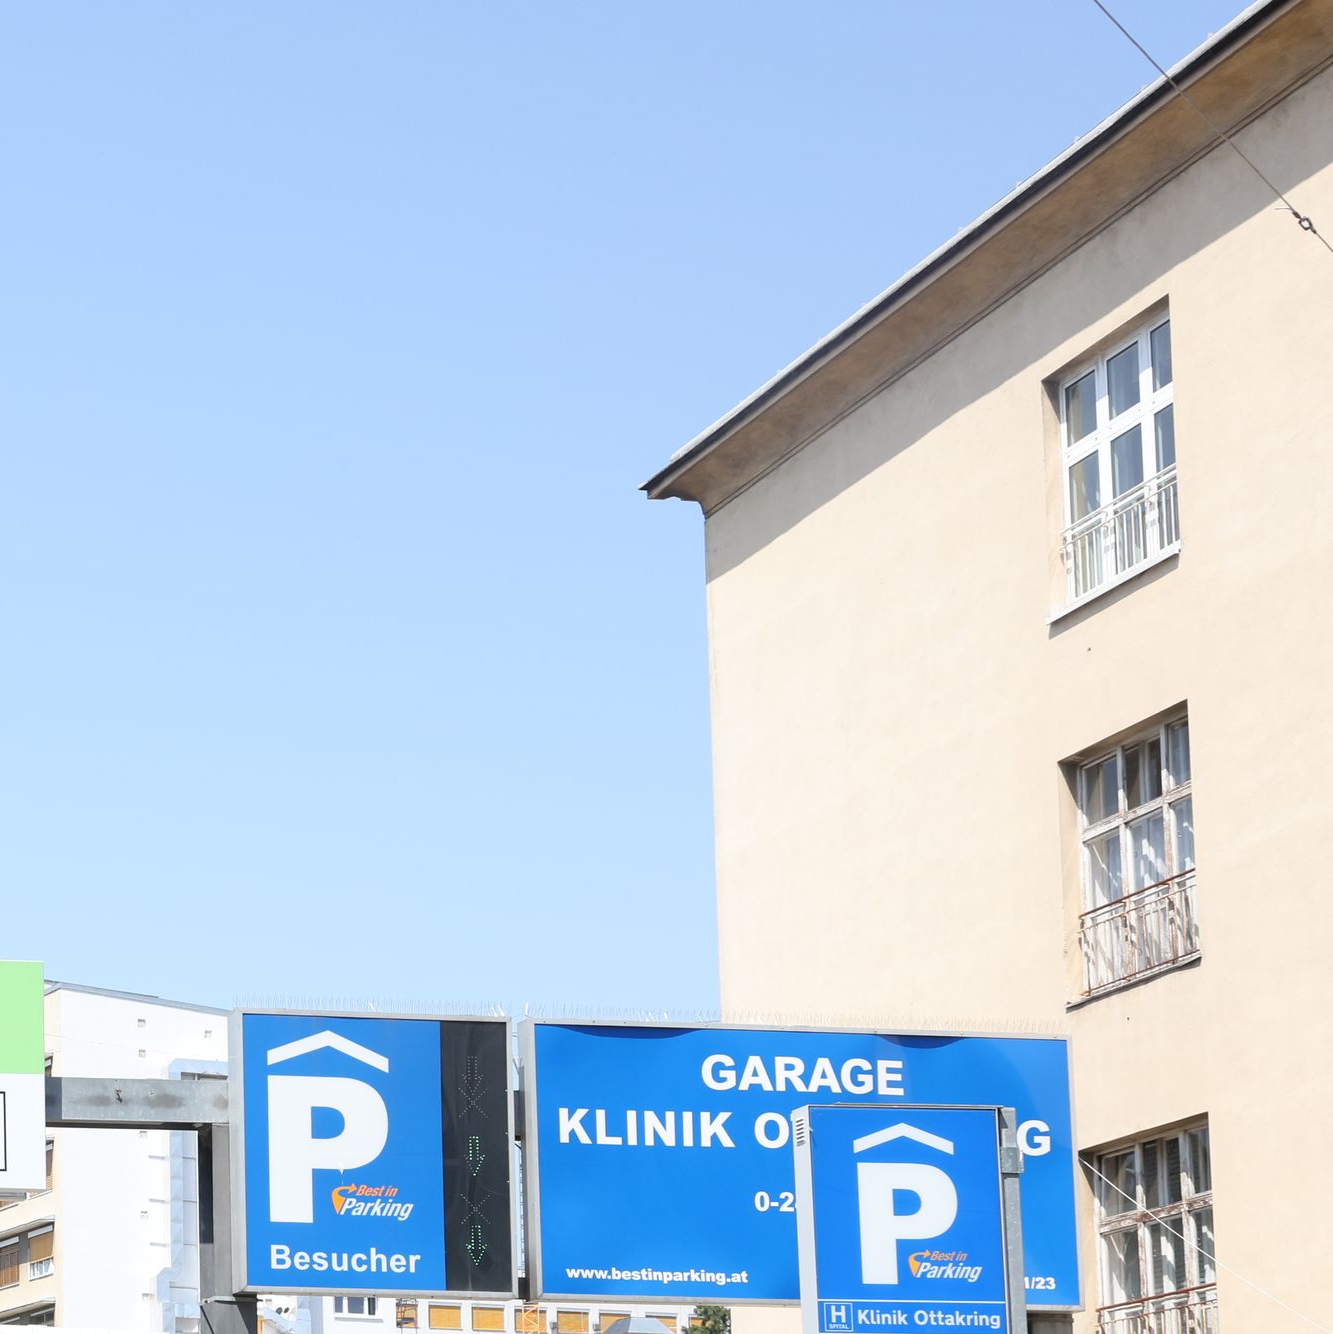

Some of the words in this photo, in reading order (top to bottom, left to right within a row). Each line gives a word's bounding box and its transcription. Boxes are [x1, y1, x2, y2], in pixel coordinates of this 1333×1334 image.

[700, 1053, 905, 1096] GARAGE
[557, 1107, 736, 1149] KLINIK
[267, 1075, 389, 1223] P
[355, 1184, 384, 1197] Best
[385, 1185, 399, 1197] in
[754, 1190, 797, 1212] 0-2
[339, 1197, 414, 1222] Parking
[856, 1162, 958, 1285] P
[269, 1243, 422, 1274] Besucher
[929, 1250, 955, 1261] Best
[956, 1250, 968, 1262] in
[565, 1267, 749, 1286] www.bestinparking.at
[916, 1261, 983, 1283] Parking
[830, 1305, 846, 1324] H
[857, 1308, 908, 1326] Klinik
[913, 1309, 1001, 1330] Ottakring
